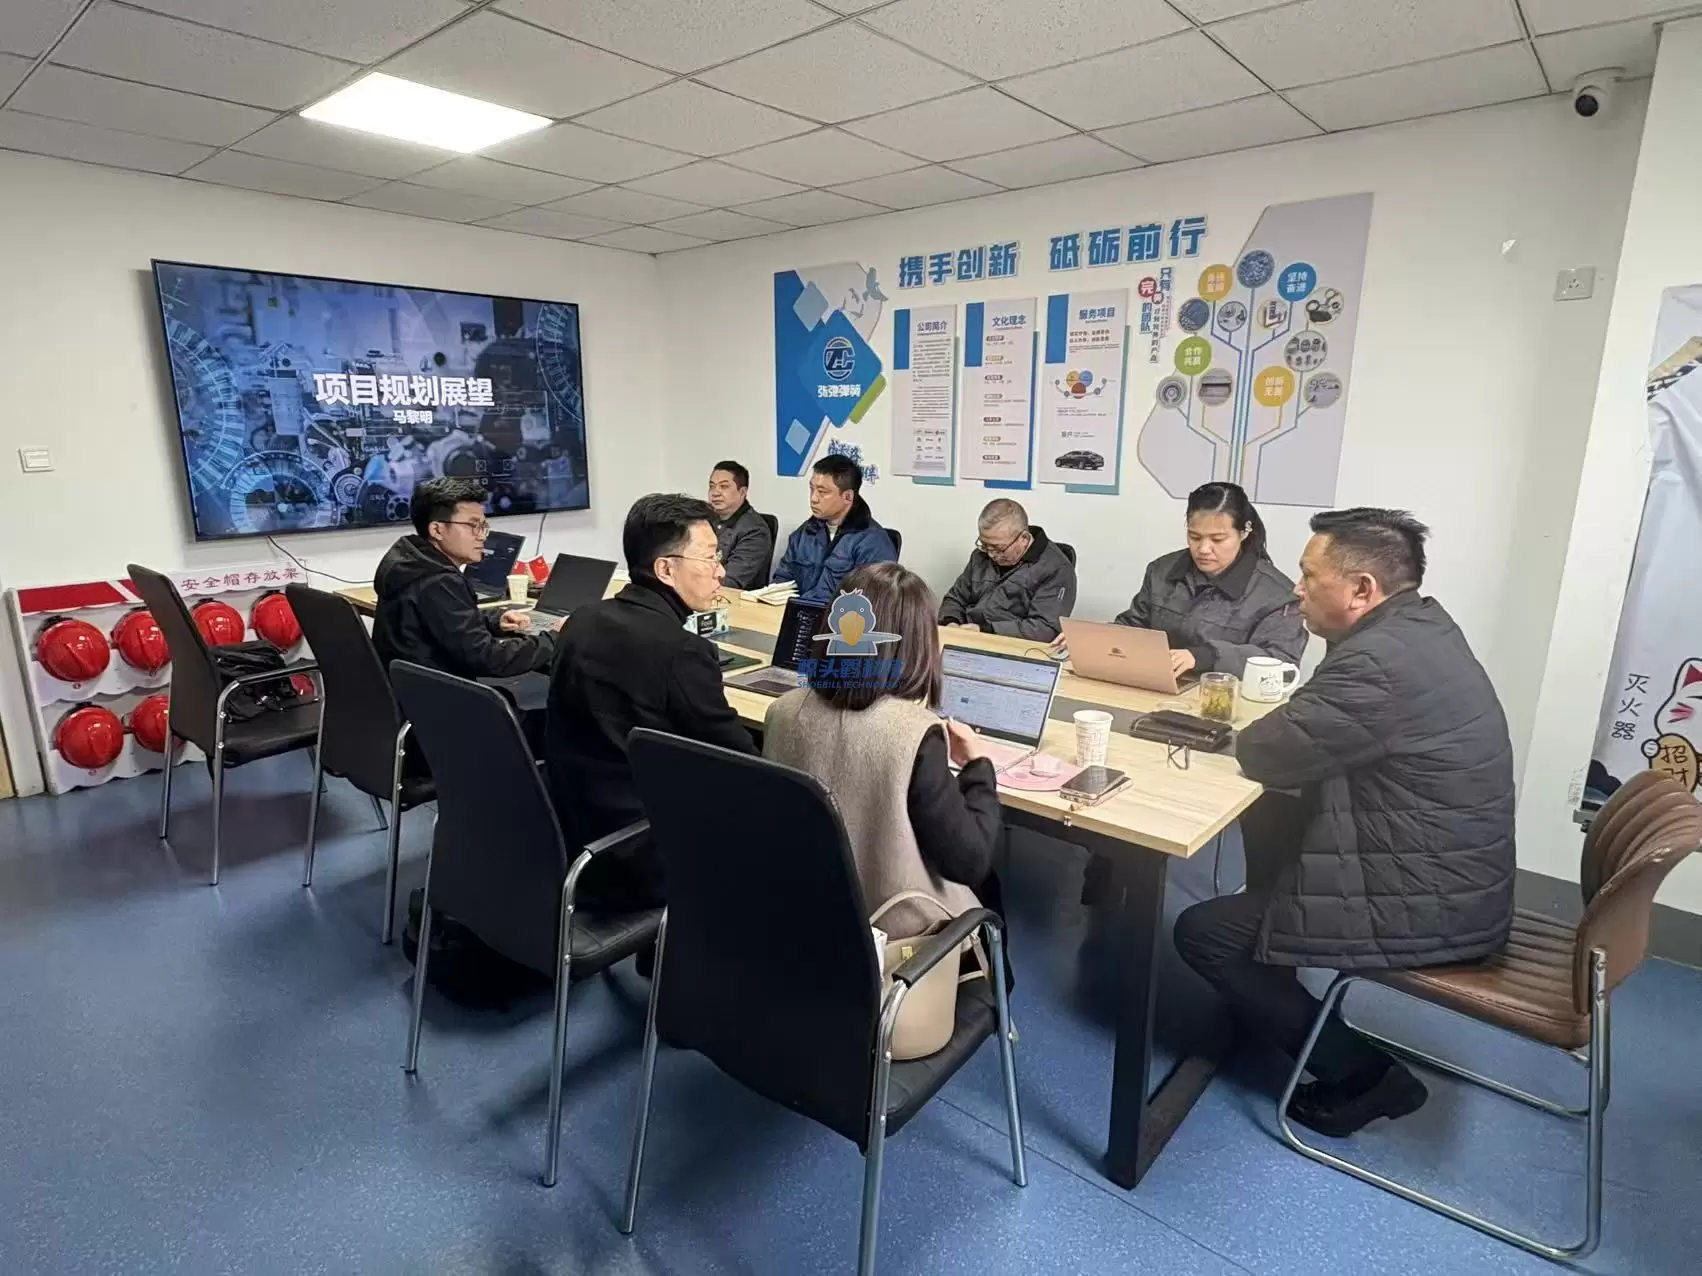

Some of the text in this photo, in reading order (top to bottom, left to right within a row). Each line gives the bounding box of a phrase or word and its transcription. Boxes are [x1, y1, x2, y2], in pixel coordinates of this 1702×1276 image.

[899, 217, 1206, 288] 携手创新 砥砺前行
[992, 314, 1026, 327] 文化理念
[1079, 307, 1115, 320] 服务项目
[917, 320, 947, 331] 公司简介
[313, 373, 495, 407] 项目规划展望
[392, 410, 433, 424] 马黎明
[181, 568, 299, 591] 安全帽存放架
[1611, 673, 1651, 740] 灭火器
